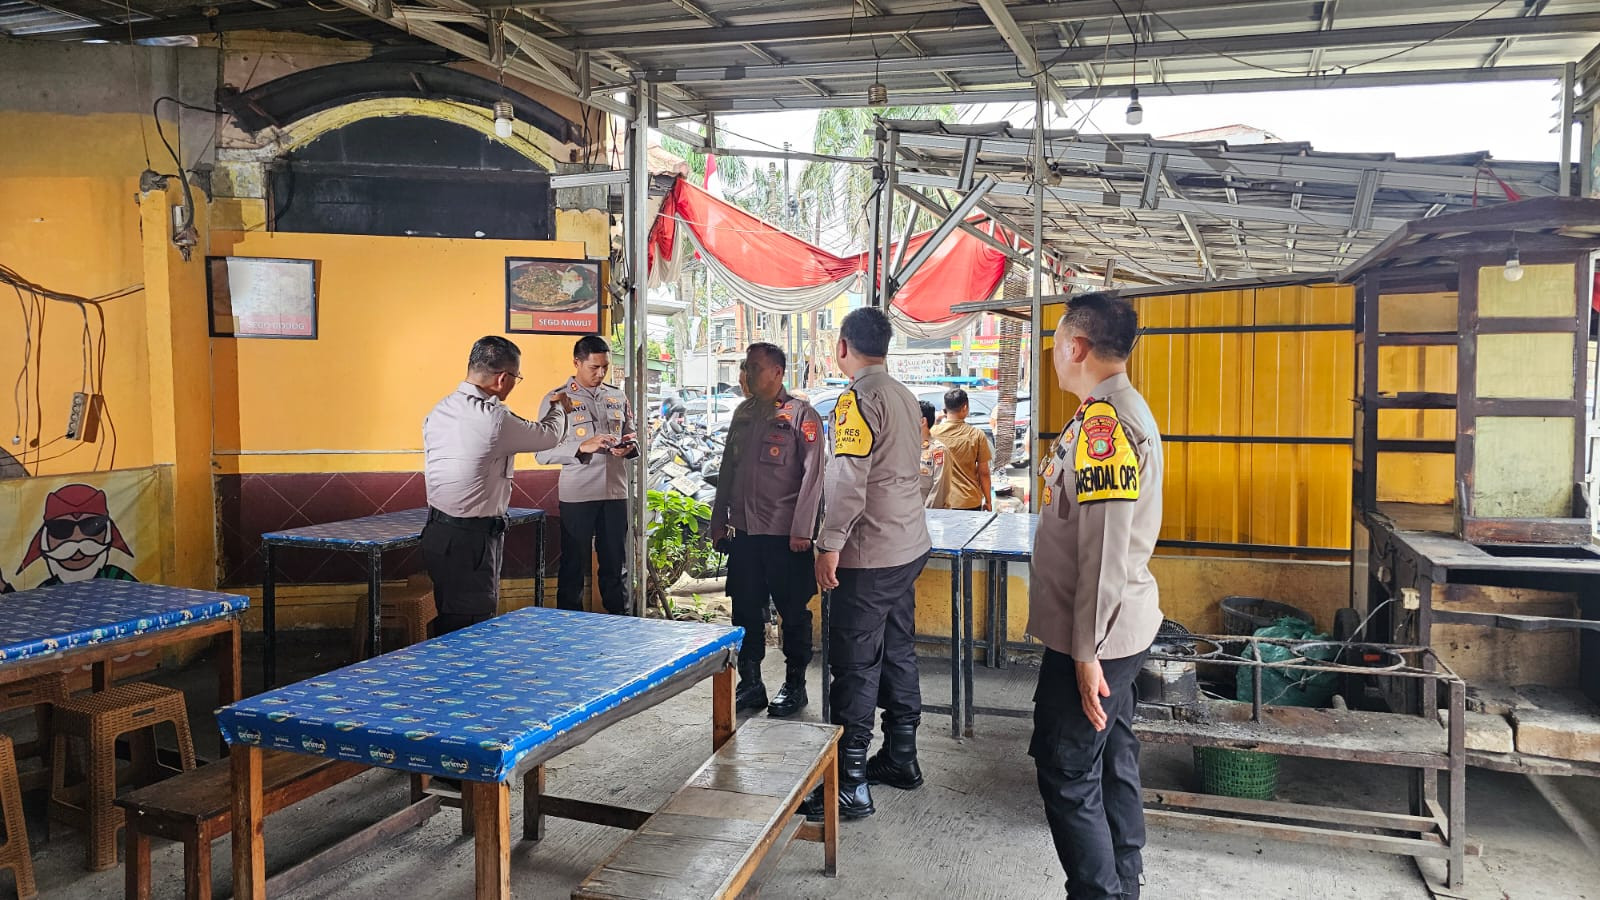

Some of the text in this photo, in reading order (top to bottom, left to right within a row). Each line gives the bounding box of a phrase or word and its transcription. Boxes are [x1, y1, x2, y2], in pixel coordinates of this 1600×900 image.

[538, 318, 593, 327] SEGO MAWUT
[844, 428, 860, 437] RES
[1119, 464, 1137, 491] OPS
[369, 748, 394, 759] prima
[441, 758, 468, 769] prima
